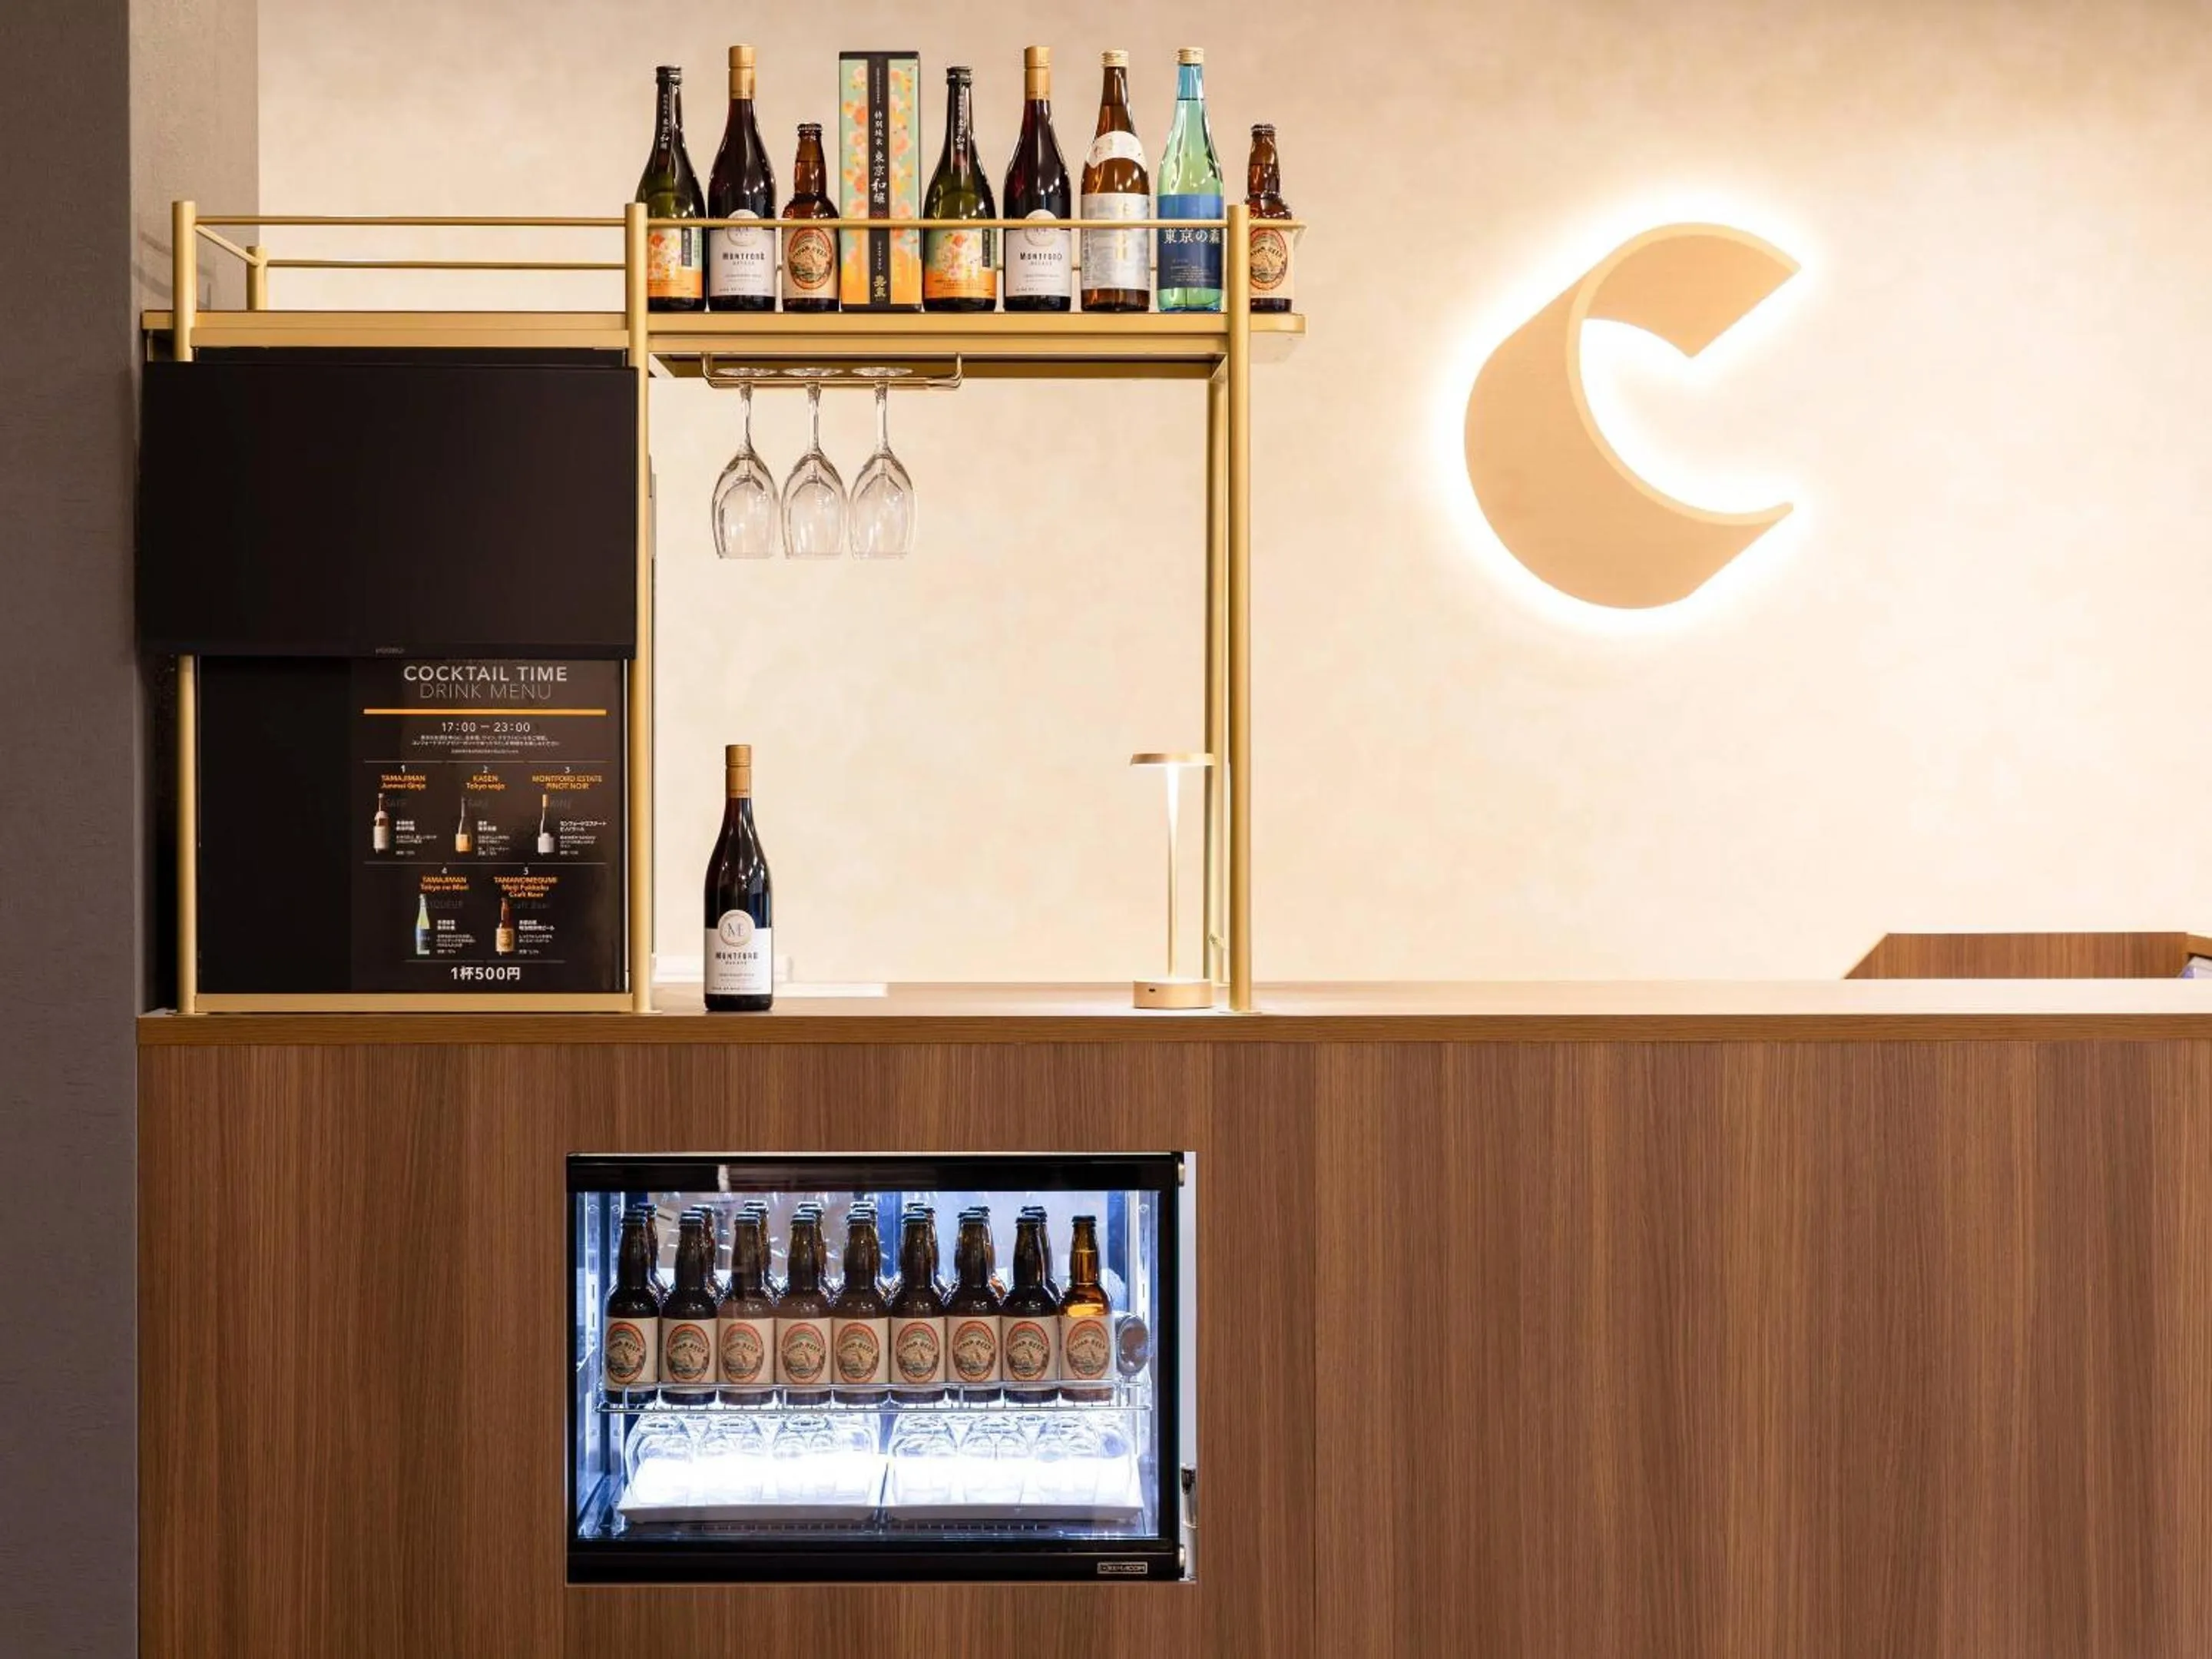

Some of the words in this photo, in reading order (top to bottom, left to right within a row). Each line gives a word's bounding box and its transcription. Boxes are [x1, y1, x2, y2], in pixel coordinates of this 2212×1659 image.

[403, 666, 509, 681] COCKTAIL
[516, 666, 568, 681] TIME
[419, 684, 482, 700] DRINK
[490, 684, 551, 700] MENU
[442, 722, 476, 732] 17:00
[493, 722, 531, 732] 23:00
[450, 965, 521, 980] 1杯500円
